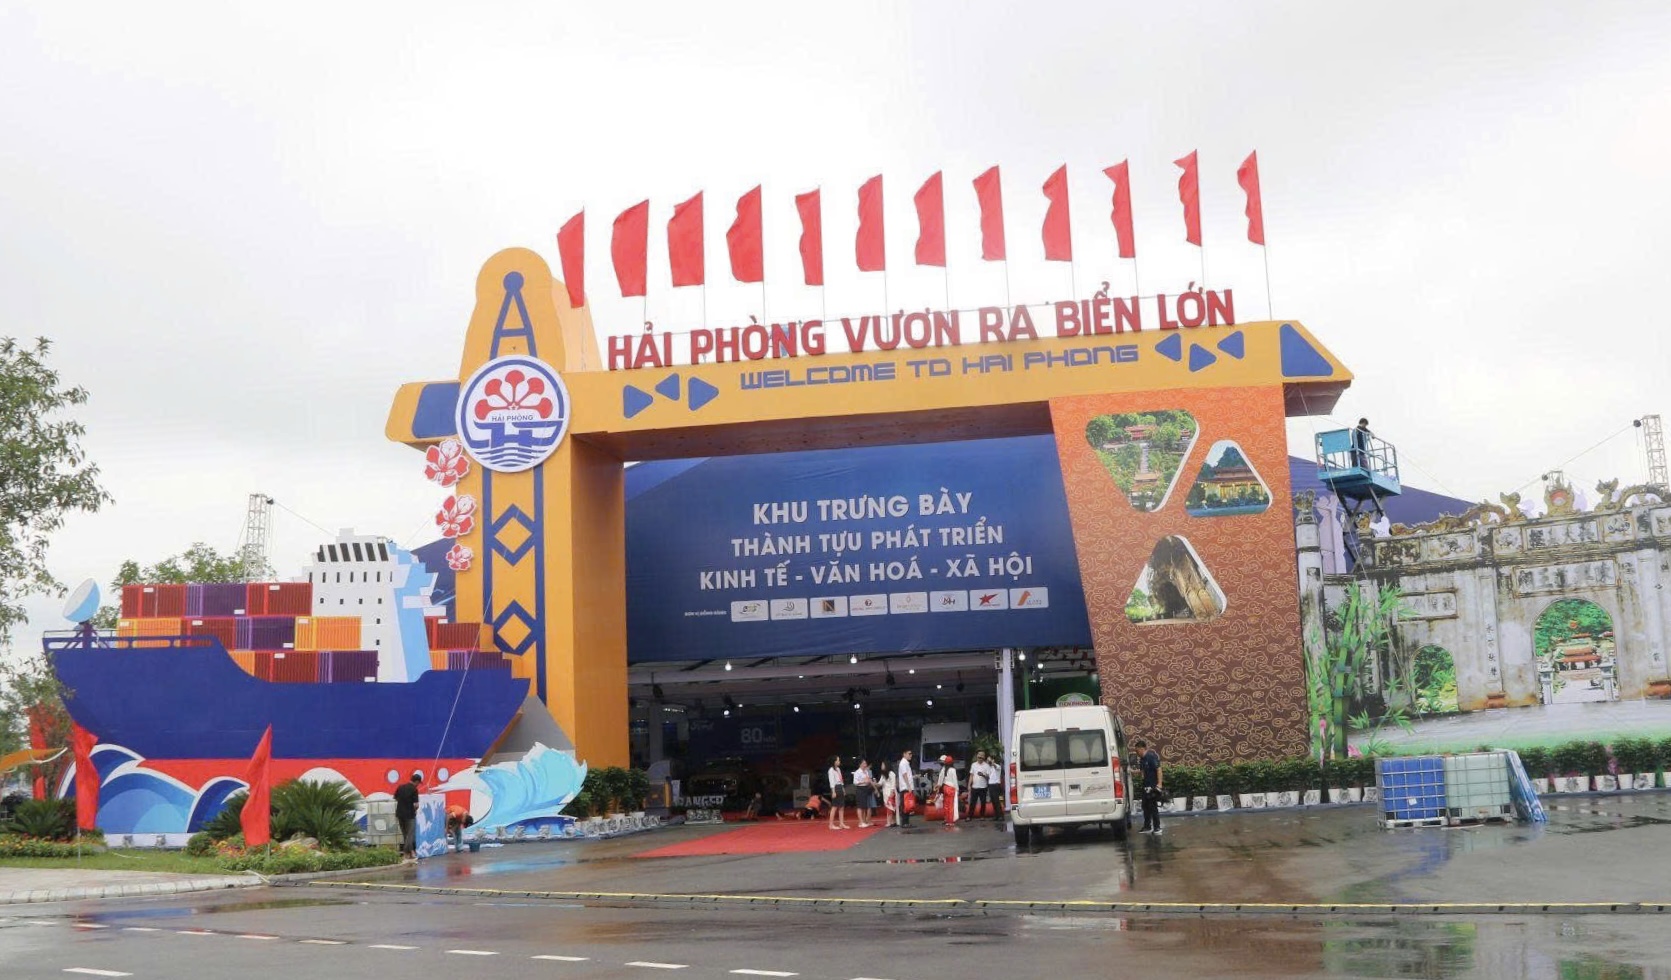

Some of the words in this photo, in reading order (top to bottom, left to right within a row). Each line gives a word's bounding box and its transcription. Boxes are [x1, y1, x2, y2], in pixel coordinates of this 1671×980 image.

[608, 321, 673, 371] HẢI
[690, 315, 826, 365] PHÒNG
[841, 307, 962, 354] VƯƠN
[979, 304, 1039, 343] RA
[1055, 281, 1142, 338] BIỂN
[1158, 282, 1235, 330] LỚN
[740, 362, 896, 390] WELCOME
[906, 359, 951, 379] TO
[963, 353, 1014, 374] HAI
[1024, 343, 1139, 370] PHONG
[753, 502, 808, 525] KHU
[816, 495, 910, 521] TRƯNG
[919, 487, 973, 516] BÀY
[731, 530, 811, 557] THÀNH
[819, 530, 862, 557] TỰU
[870, 524, 931, 551] PHÁT
[938, 517, 1004, 547] TRIỂN
[700, 569, 757, 591] KINH
[764, 560, 791, 587] TẾ
[810, 561, 861, 585] VĂN
[870, 556, 923, 581] HOÁ
[946, 552, 981, 579] XÃ
[988, 552, 1033, 581] HỘI
[741, 728, 762, 744] 80
